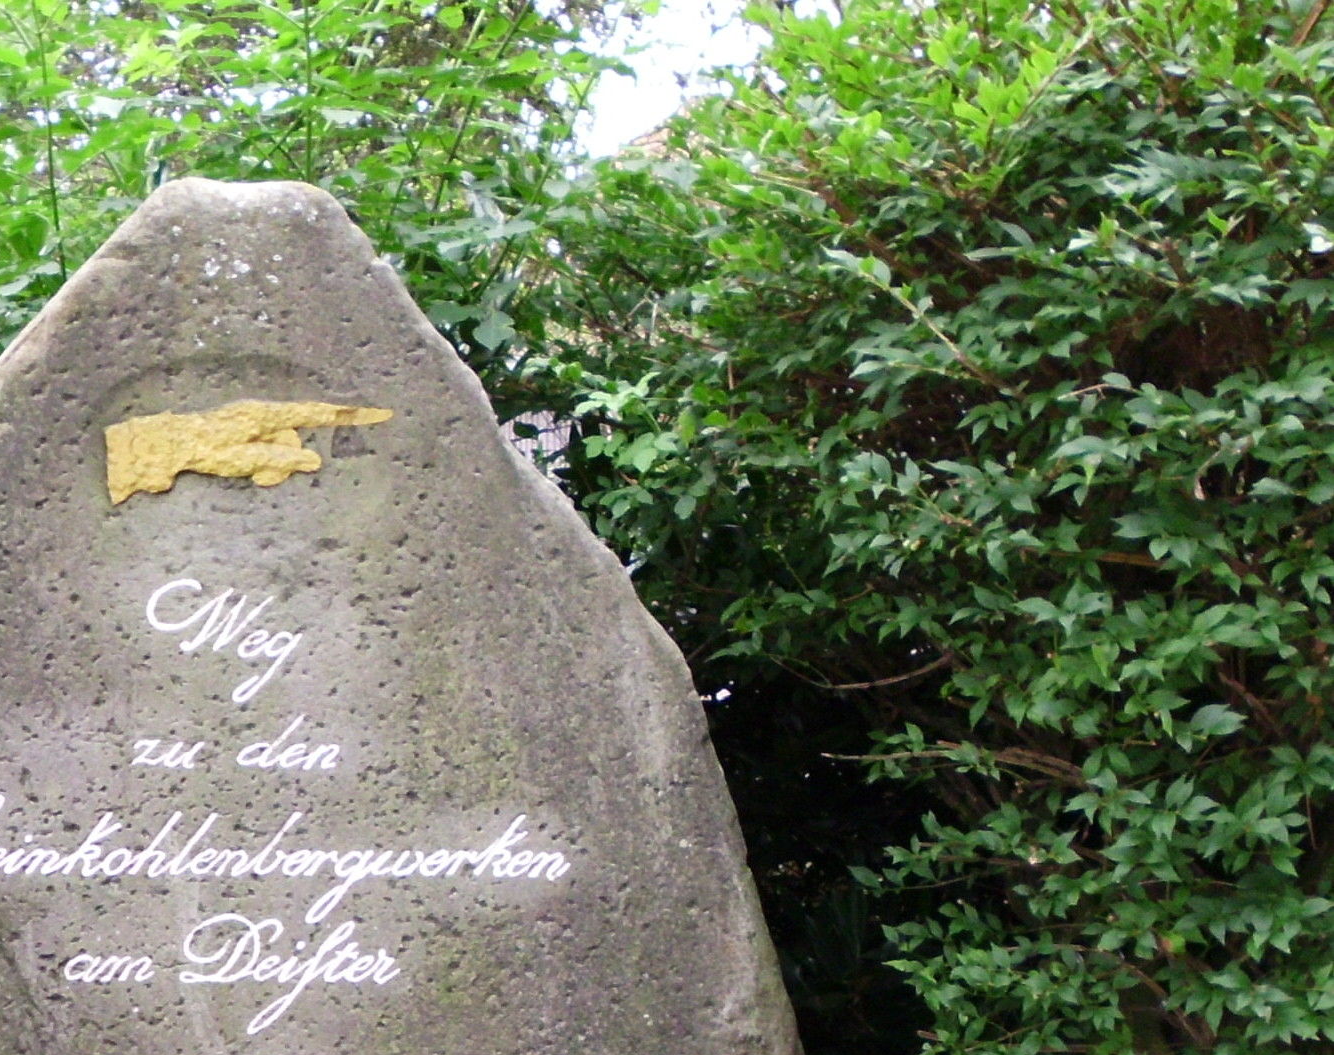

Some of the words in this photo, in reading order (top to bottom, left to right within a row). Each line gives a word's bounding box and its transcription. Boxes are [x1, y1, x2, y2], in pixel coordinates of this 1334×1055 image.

[144, 577, 302, 702] Weg
[133, 737, 199, 768] zu
[235, 714, 339, 770] den
[63, 951, 155, 983] am
